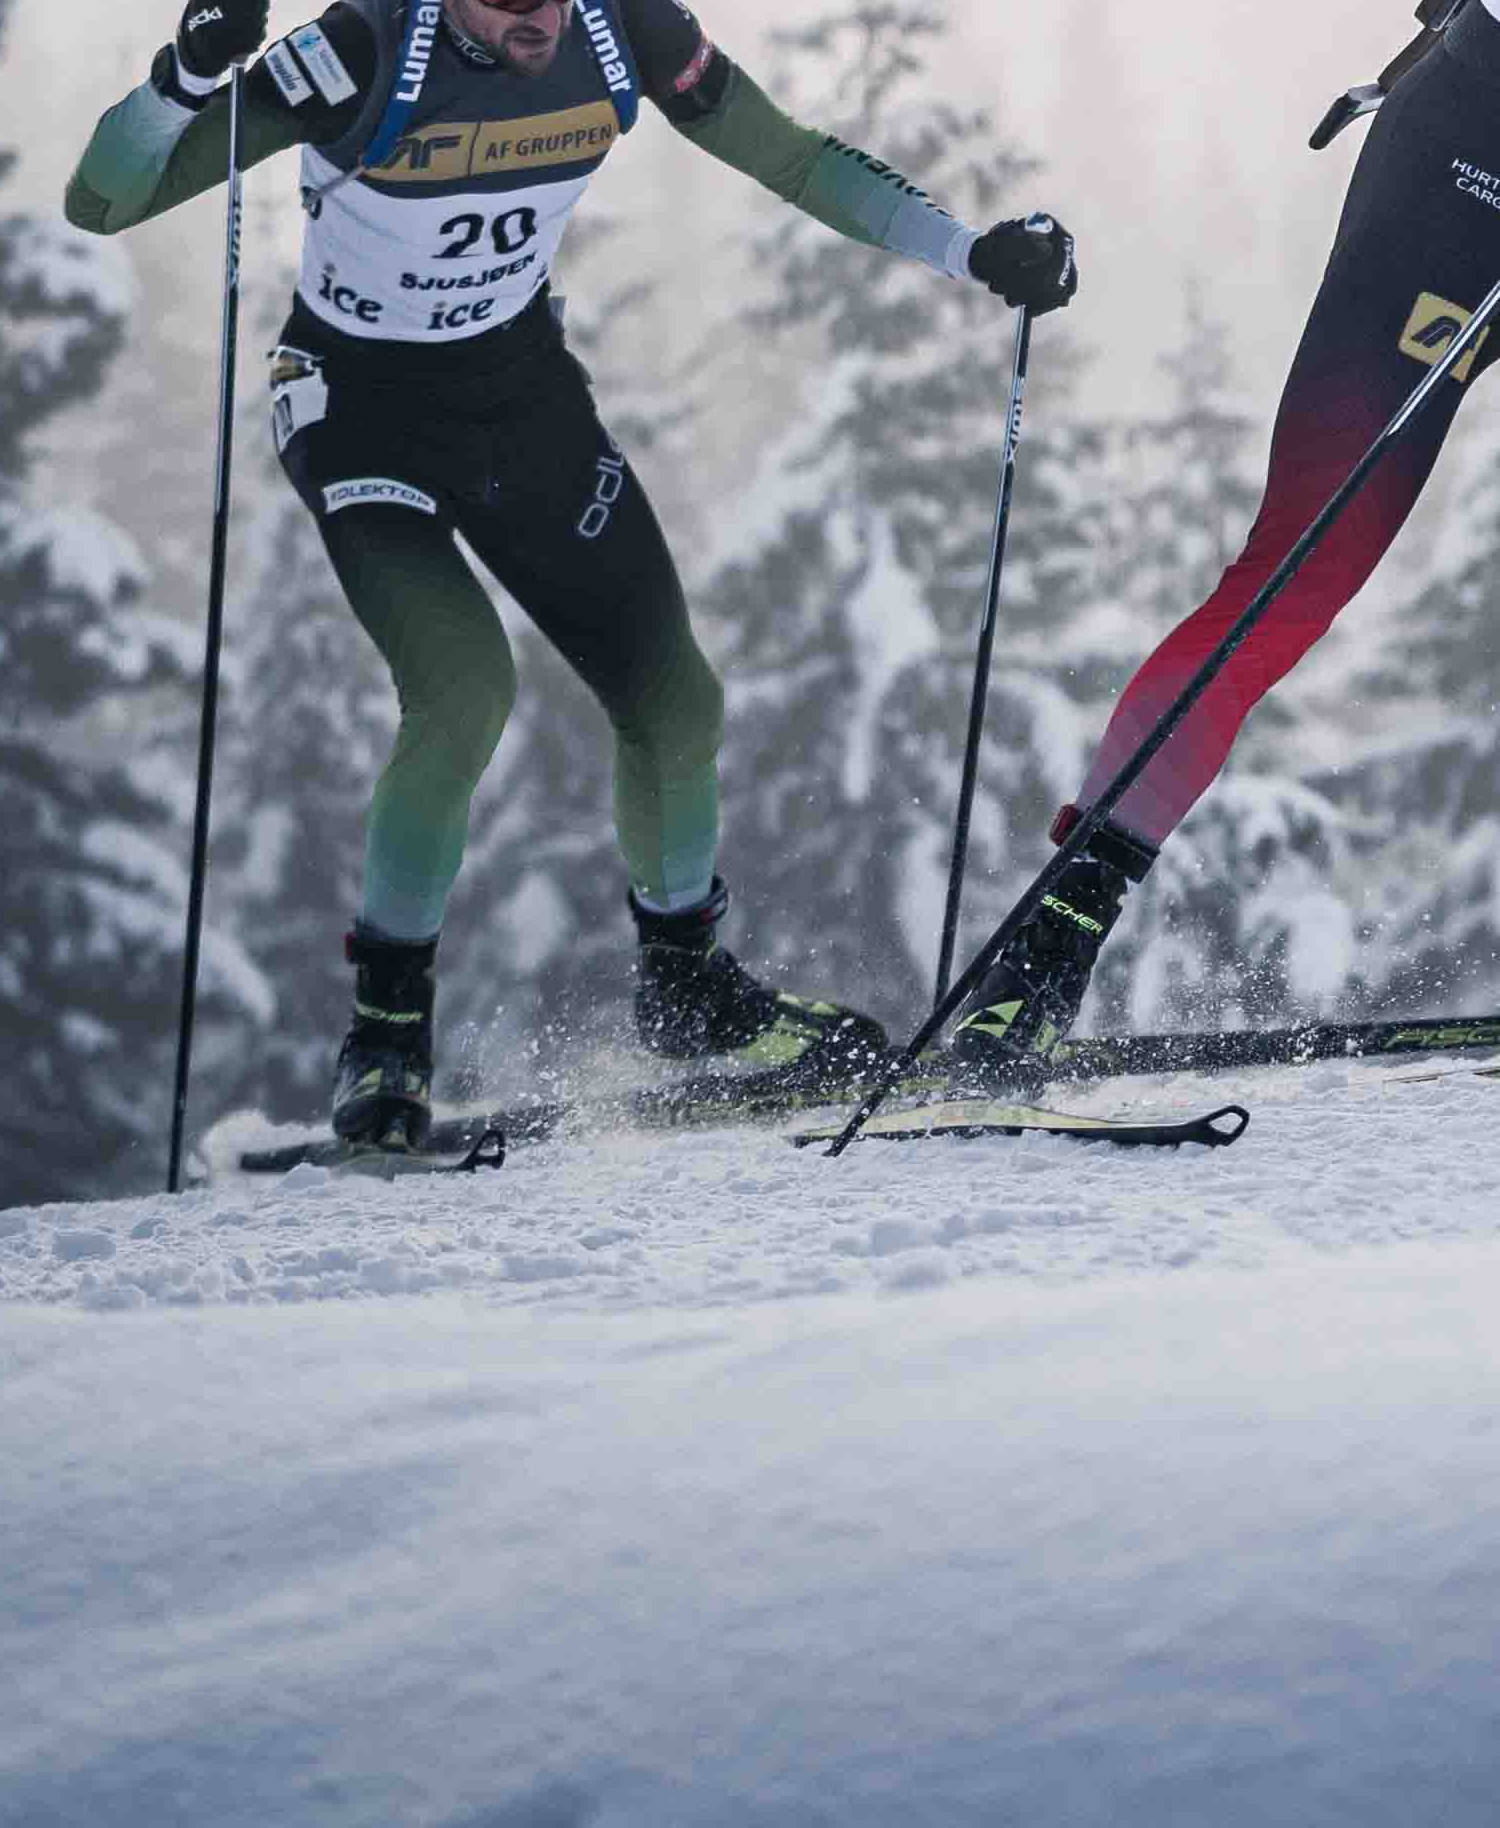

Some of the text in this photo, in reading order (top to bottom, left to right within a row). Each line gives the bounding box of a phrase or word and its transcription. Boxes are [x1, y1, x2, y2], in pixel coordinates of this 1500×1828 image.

[484, 123, 613, 162] AF GRUPPEN
[431, 207, 537, 260] 20
[400, 250, 538, 291] SJUSJØEN
[318, 262, 384, 323] ice
[427, 300, 495, 330] ice
